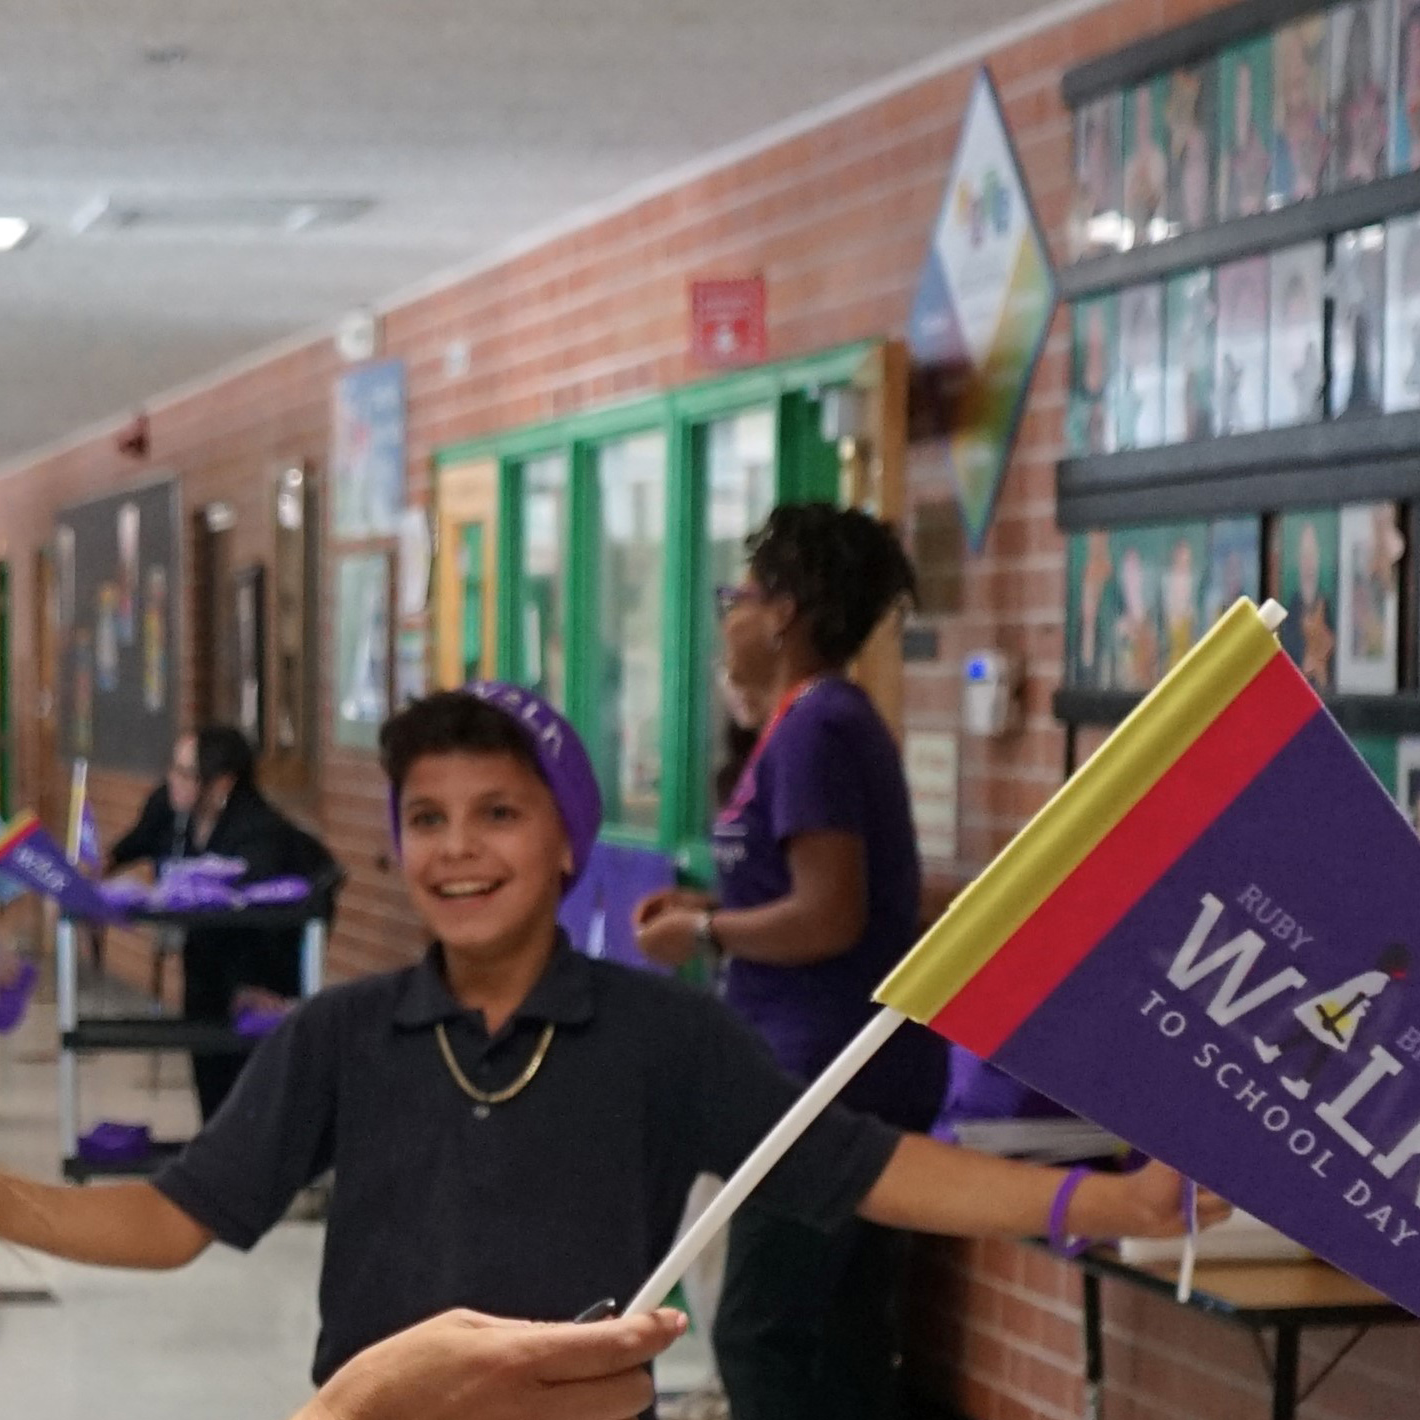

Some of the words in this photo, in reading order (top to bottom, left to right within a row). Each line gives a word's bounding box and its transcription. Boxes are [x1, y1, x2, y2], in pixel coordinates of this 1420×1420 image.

[1236, 884, 1314, 952] RUBY
[1140, 990, 1186, 1037] TO
[1193, 1042, 1339, 1178] SCHOOL
[1342, 1178, 1418, 1247] DAY
